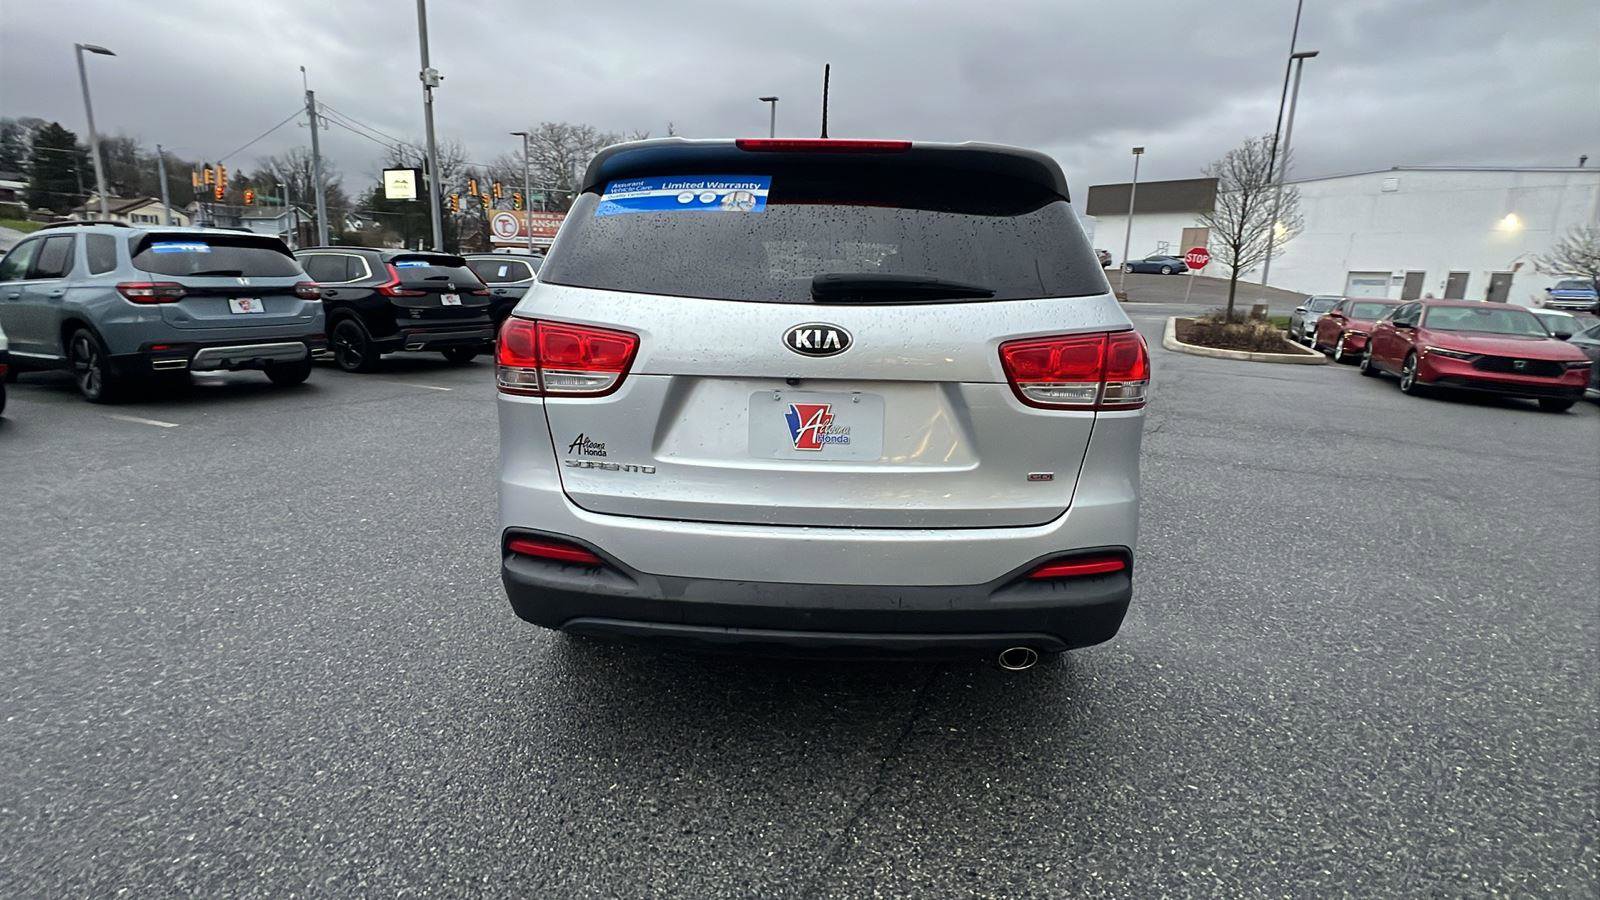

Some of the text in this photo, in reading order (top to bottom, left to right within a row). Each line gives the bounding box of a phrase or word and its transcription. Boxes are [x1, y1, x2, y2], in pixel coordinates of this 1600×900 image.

[662, 182, 761, 191] Limited Warranty
[1186, 253, 1209, 264] STOP
[795, 329, 841, 349] KIA
[816, 434, 849, 444] Honda
[583, 448, 607, 457] Honda
[565, 459, 656, 474] SORENTO
